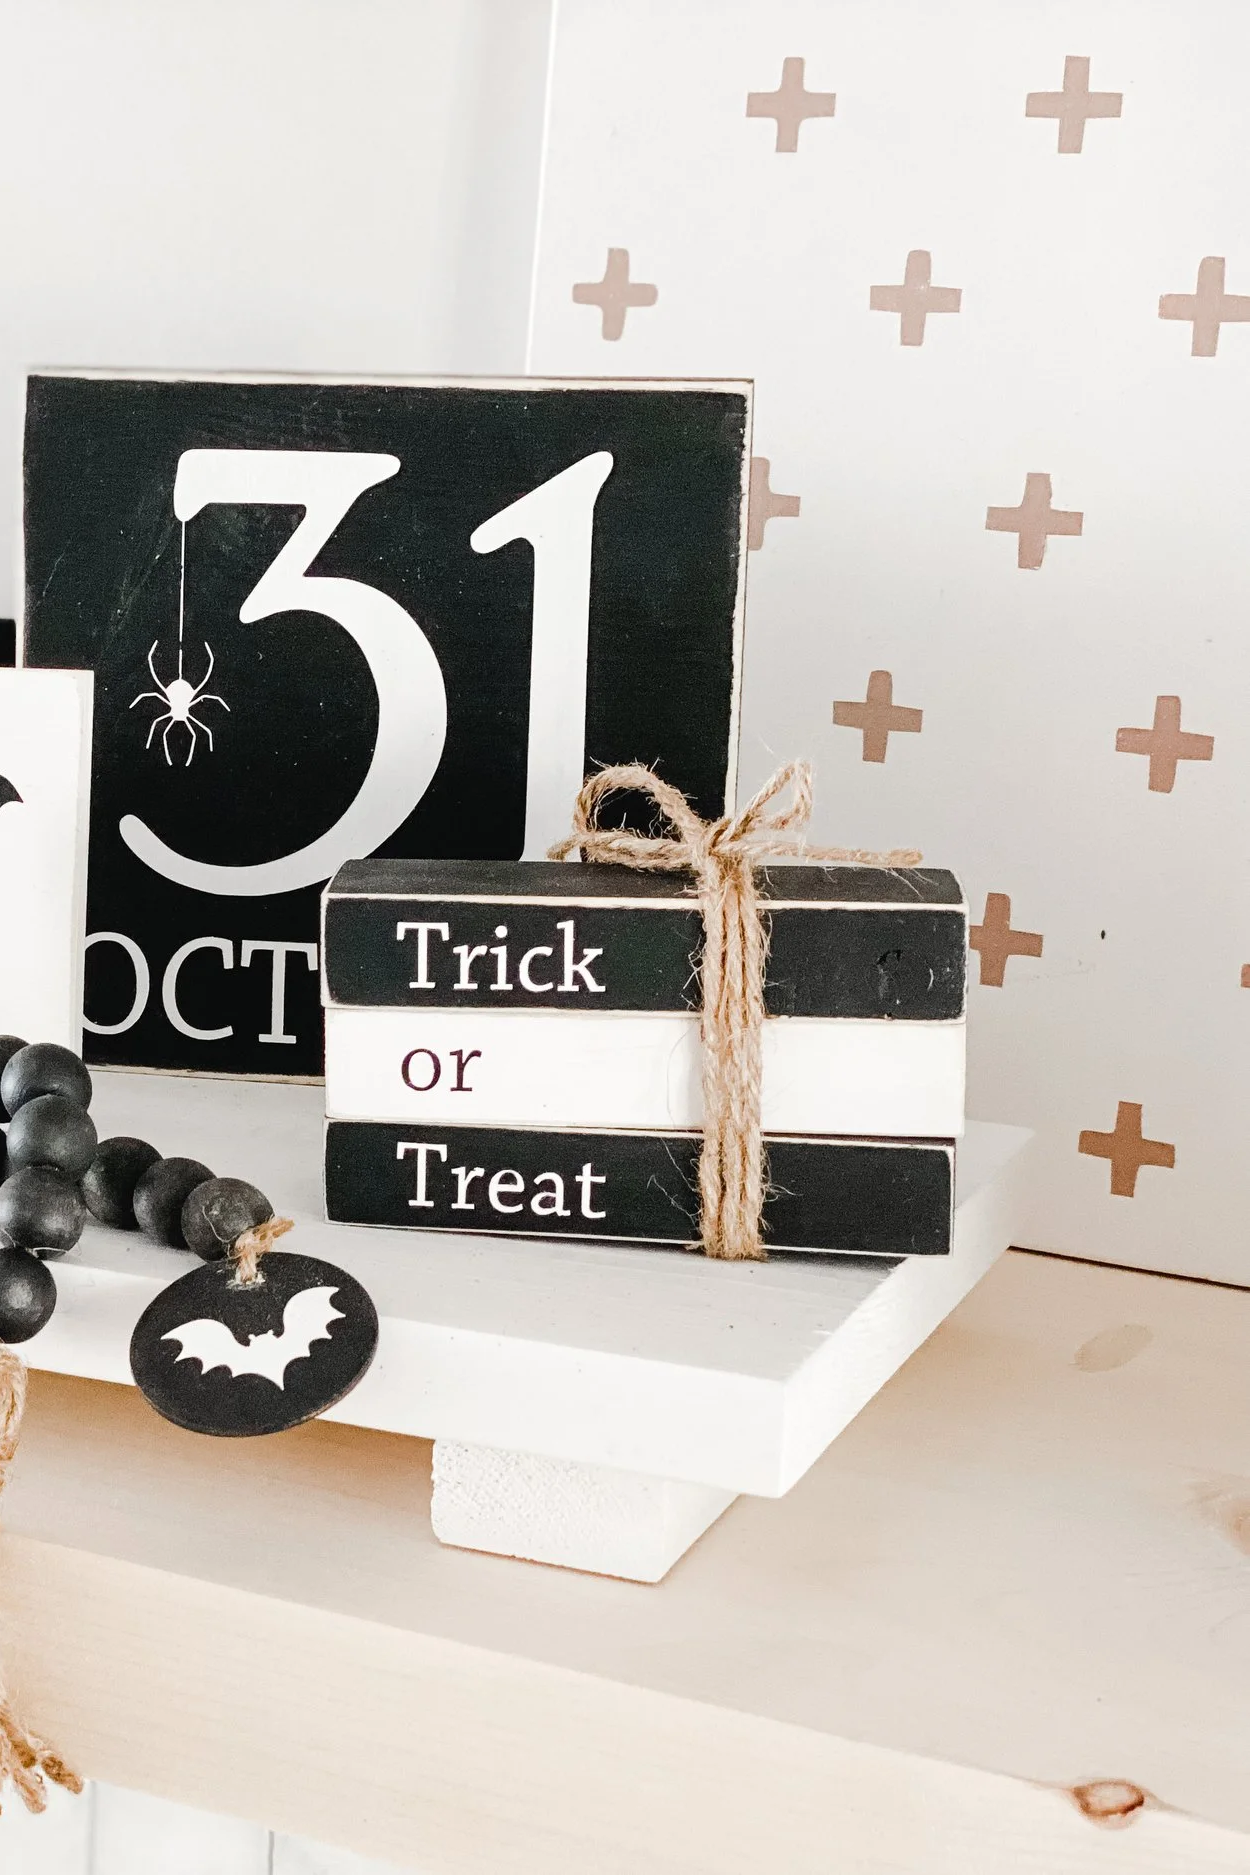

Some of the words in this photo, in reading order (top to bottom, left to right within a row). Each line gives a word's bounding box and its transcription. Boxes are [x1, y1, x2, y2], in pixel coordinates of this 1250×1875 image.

[119, 448, 614, 896] 31
[396, 920, 607, 994] Trick
[400, 1046, 483, 1094] or
[396, 1142, 607, 1219] Treat
